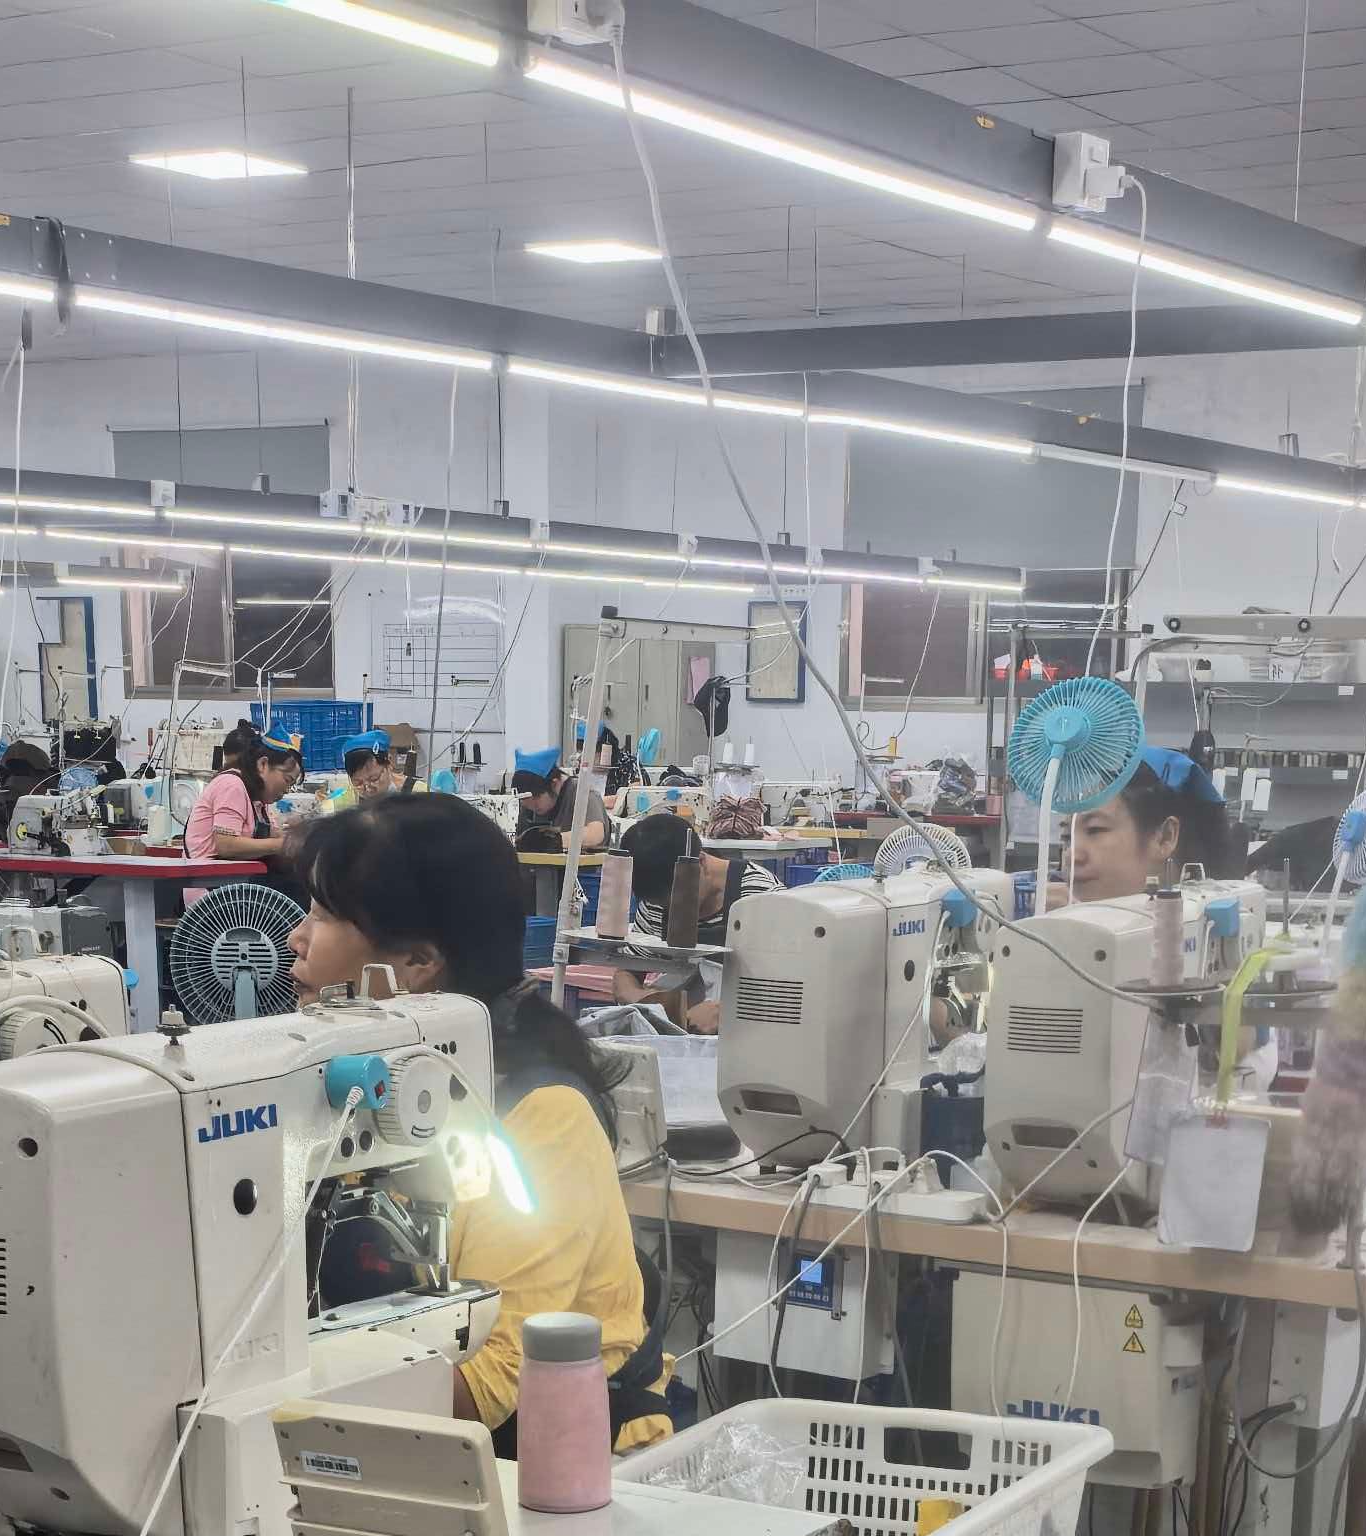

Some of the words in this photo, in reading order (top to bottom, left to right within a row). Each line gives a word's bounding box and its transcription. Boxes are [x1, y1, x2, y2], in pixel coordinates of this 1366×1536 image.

[892, 918, 926, 937] JUKI
[197, 1103, 278, 1143] JUKI
[1006, 1399, 1100, 1426] JUKI
